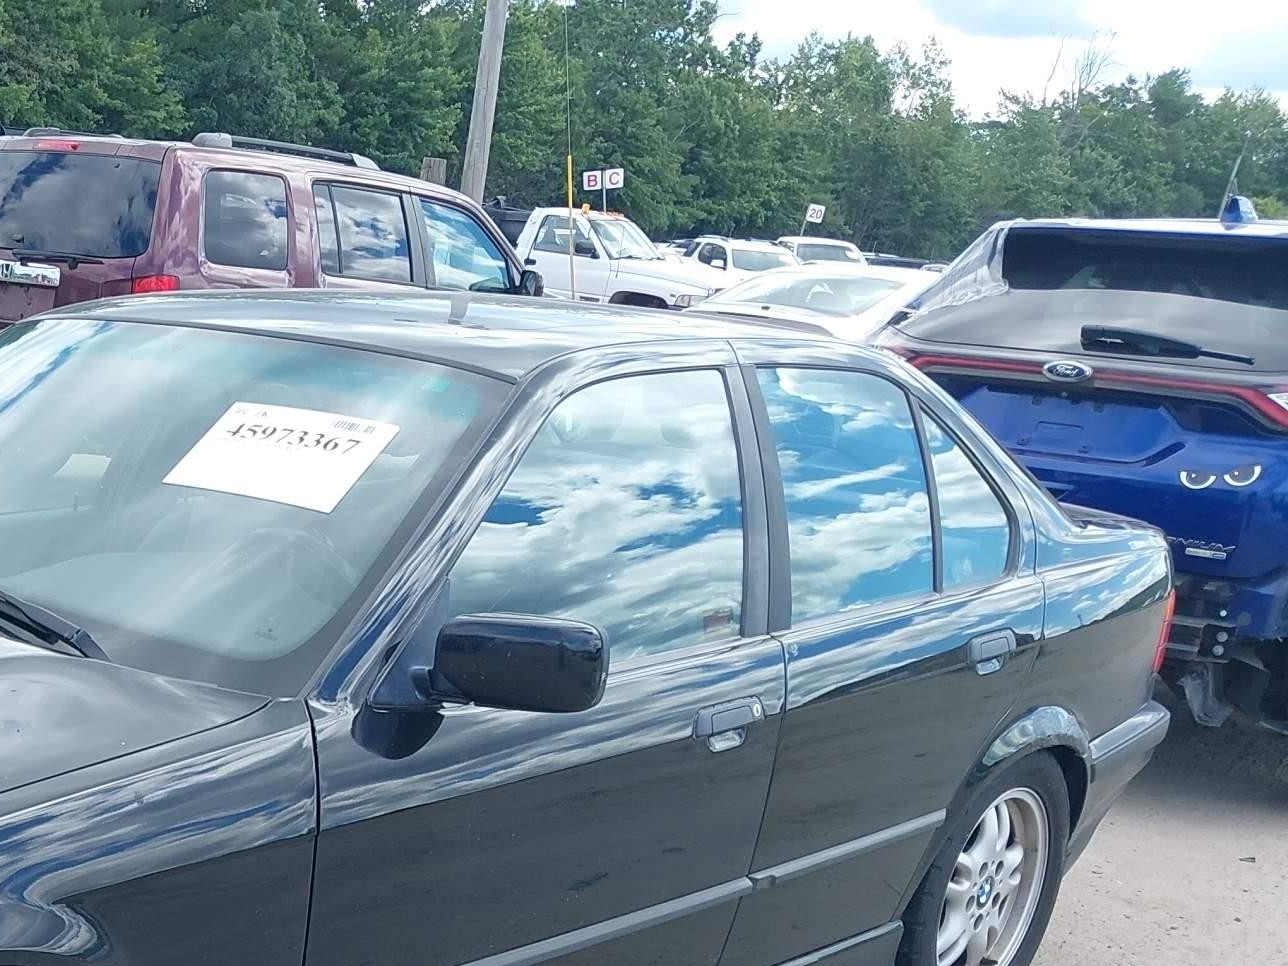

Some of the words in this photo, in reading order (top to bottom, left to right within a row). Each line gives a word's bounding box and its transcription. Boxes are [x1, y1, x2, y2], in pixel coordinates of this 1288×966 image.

[587, 174, 598, 188] B
[608, 171, 620, 186] C
[808, 208, 823, 220] 20
[226, 423, 361, 455] 45973367
